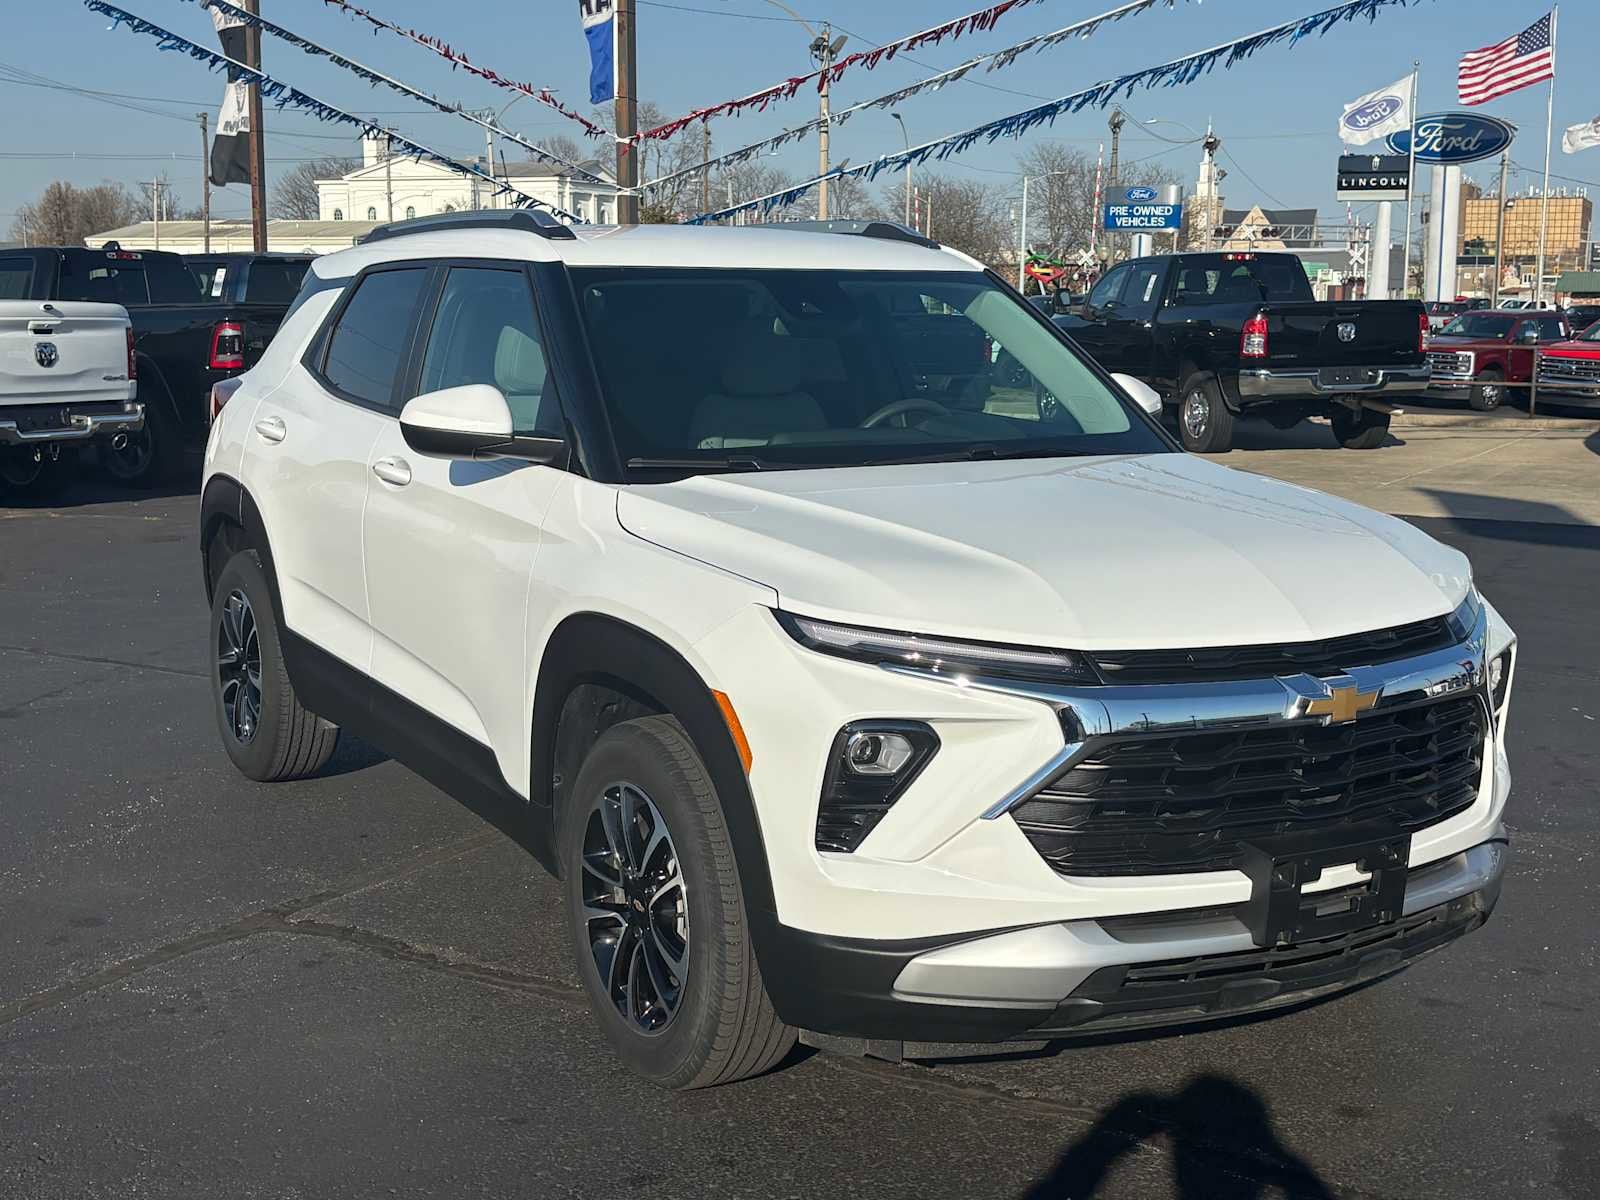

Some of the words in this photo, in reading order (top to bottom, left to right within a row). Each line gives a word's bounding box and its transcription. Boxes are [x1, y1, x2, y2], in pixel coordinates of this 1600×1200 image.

[1413, 122, 1484, 152] Ford
[1341, 176, 1408, 187] LINCOLN
[1130, 189, 1151, 199] Ford
[1109, 206, 1174, 216] PRE-OWNED
[1115, 217, 1166, 227] VEHICLES
